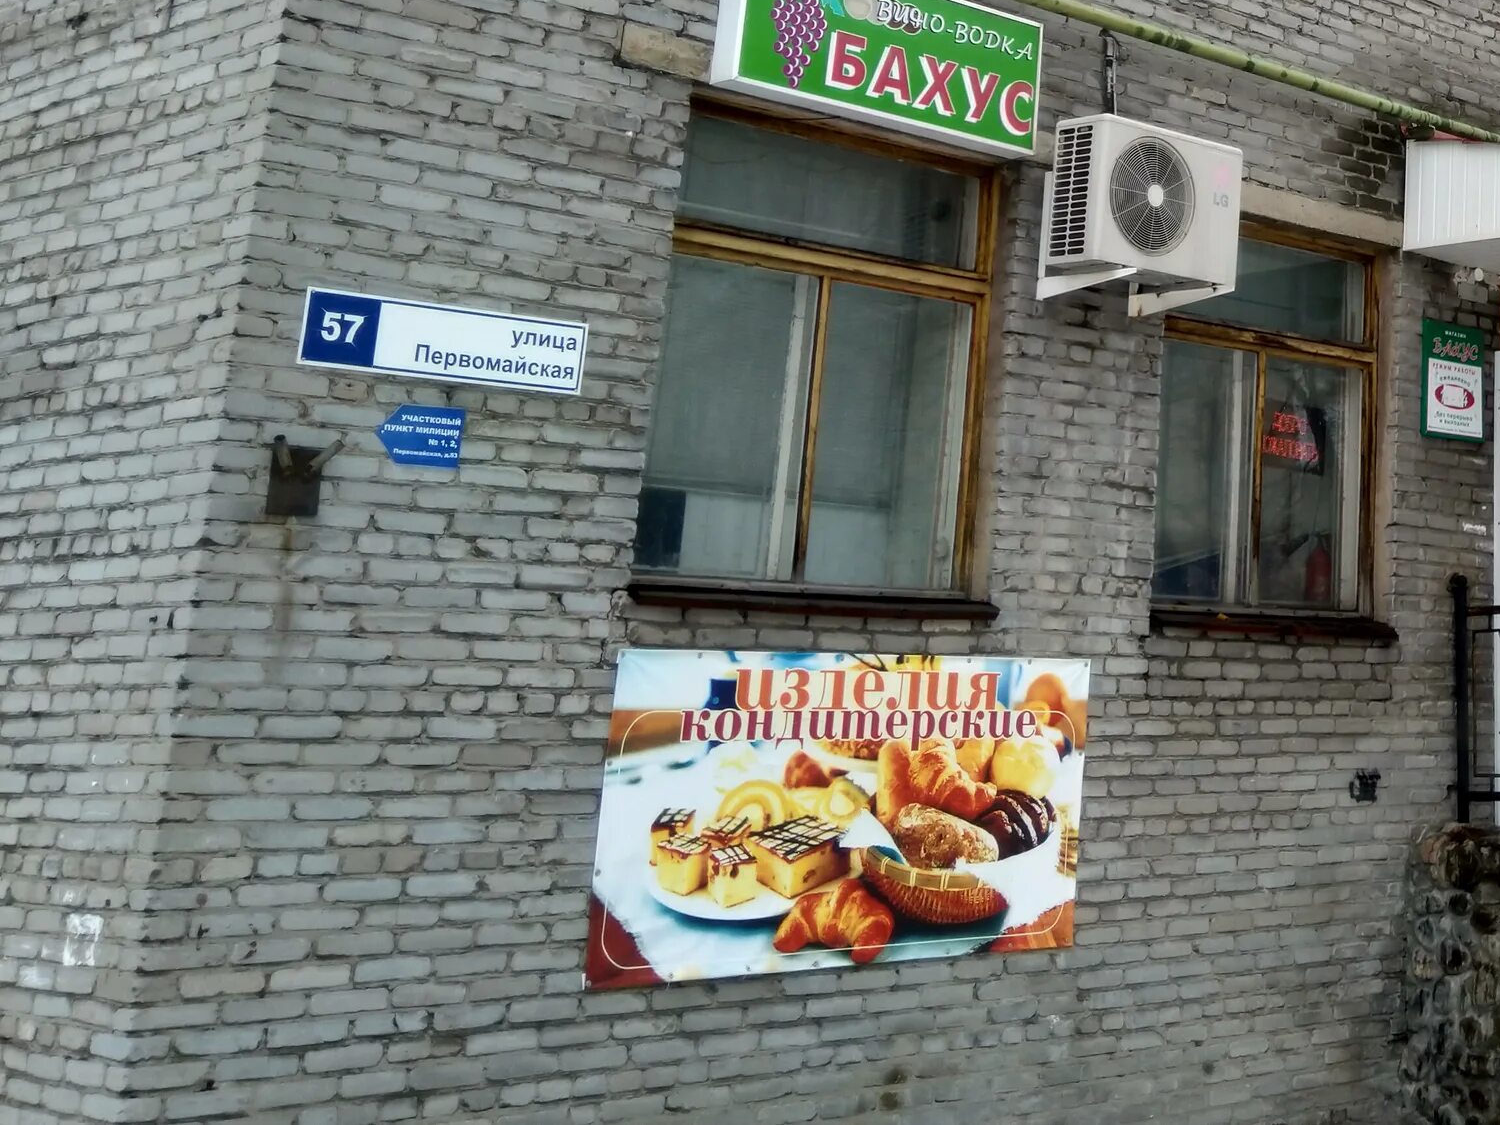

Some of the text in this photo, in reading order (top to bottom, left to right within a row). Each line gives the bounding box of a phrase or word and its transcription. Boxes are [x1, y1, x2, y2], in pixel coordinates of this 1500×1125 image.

[825, 29, 1034, 135] БАХУС
[1213, 191, 1229, 208] LG
[319, 310, 365, 346] 57
[510, 328, 577, 352] улица
[414, 342, 575, 381] Первомайская
[384, 424, 460, 437] ПУНКТ МИЛИЦИИ
[401, 415, 462, 426] УЧАСТКОВЫЙ
[428, 438, 439, 446] №
[736, 668, 1001, 711] изделия
[680, 709, 1037, 752] кондитерские
